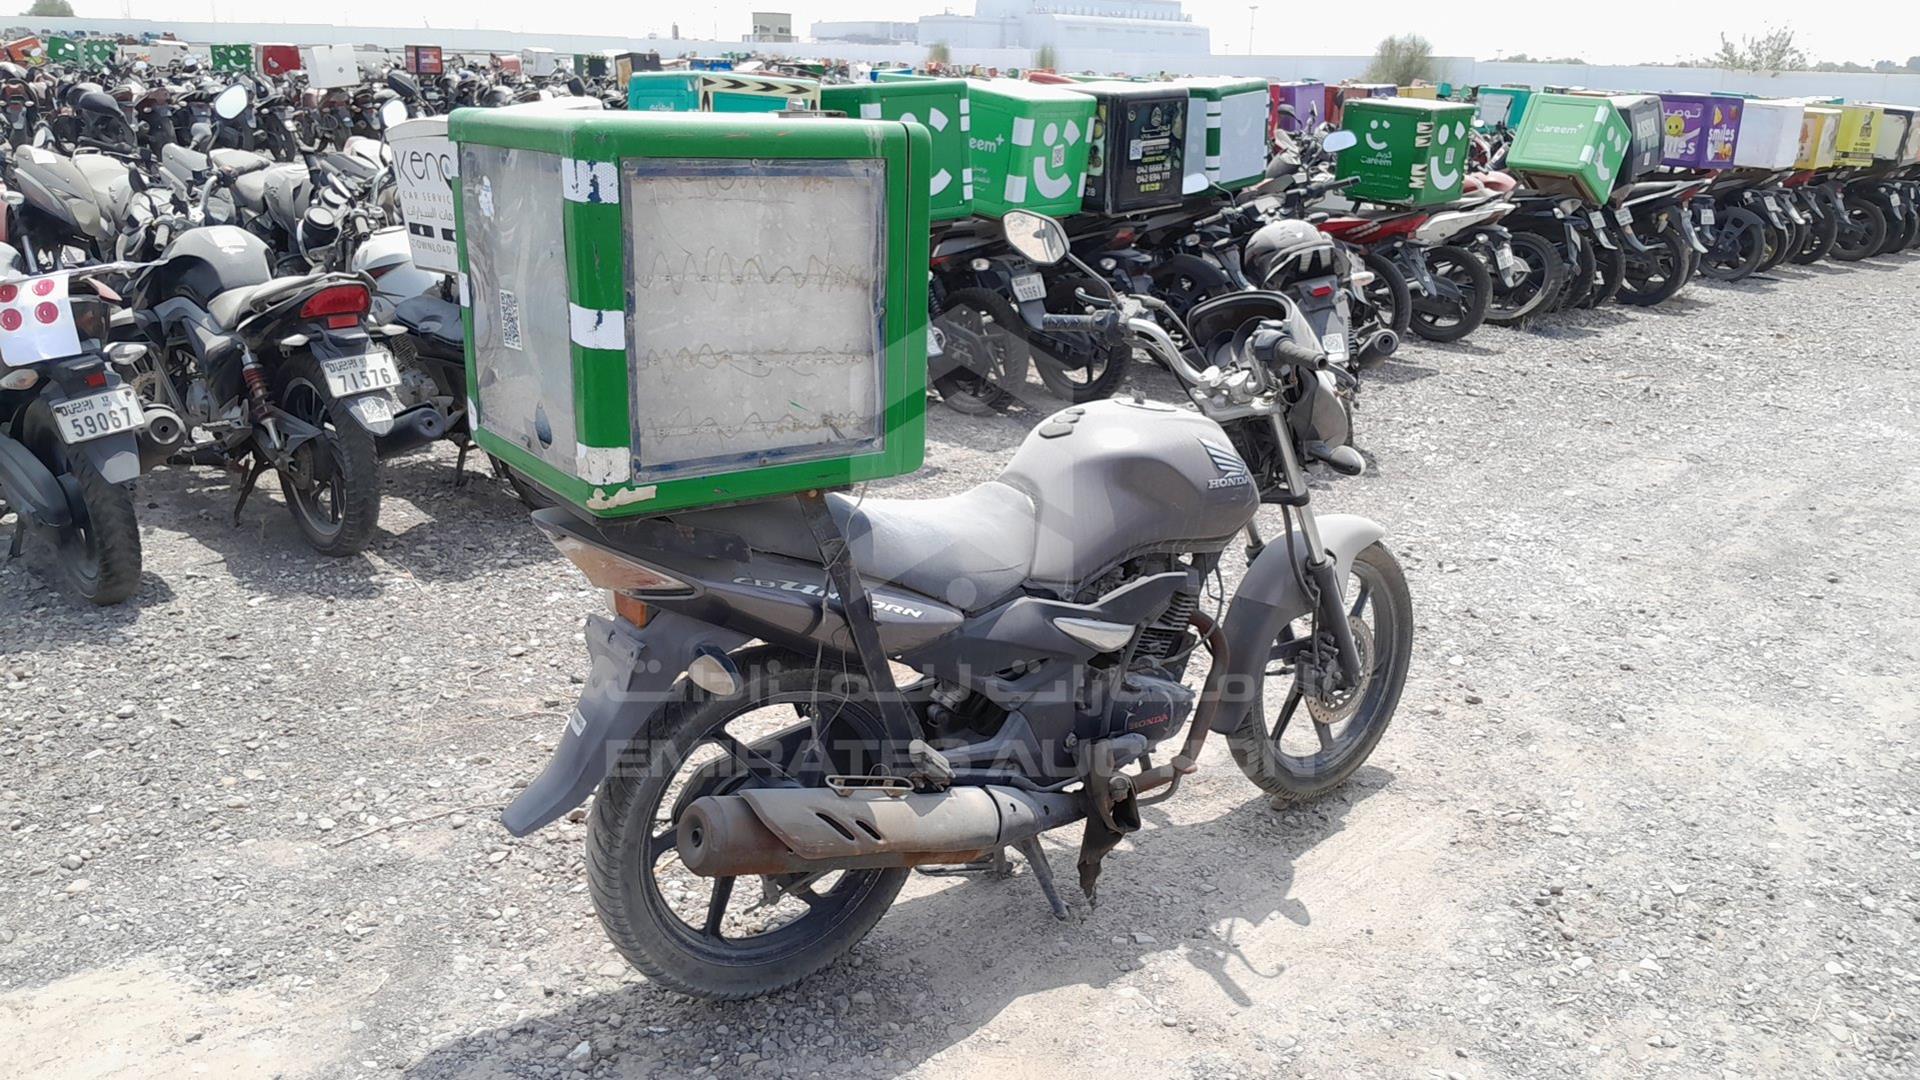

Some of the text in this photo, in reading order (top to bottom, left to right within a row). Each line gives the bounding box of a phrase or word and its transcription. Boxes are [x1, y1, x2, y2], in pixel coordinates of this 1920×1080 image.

[969, 133, 1004, 153] eem+
[1360, 155, 1392, 167] Careem
[402, 190, 452, 205] CAR SERVIC
[338, 367, 392, 392] 71576
[71, 406, 131, 437] 59067
[1208, 475, 1251, 489] HONDA
[1129, 713, 1168, 730] HONDA
